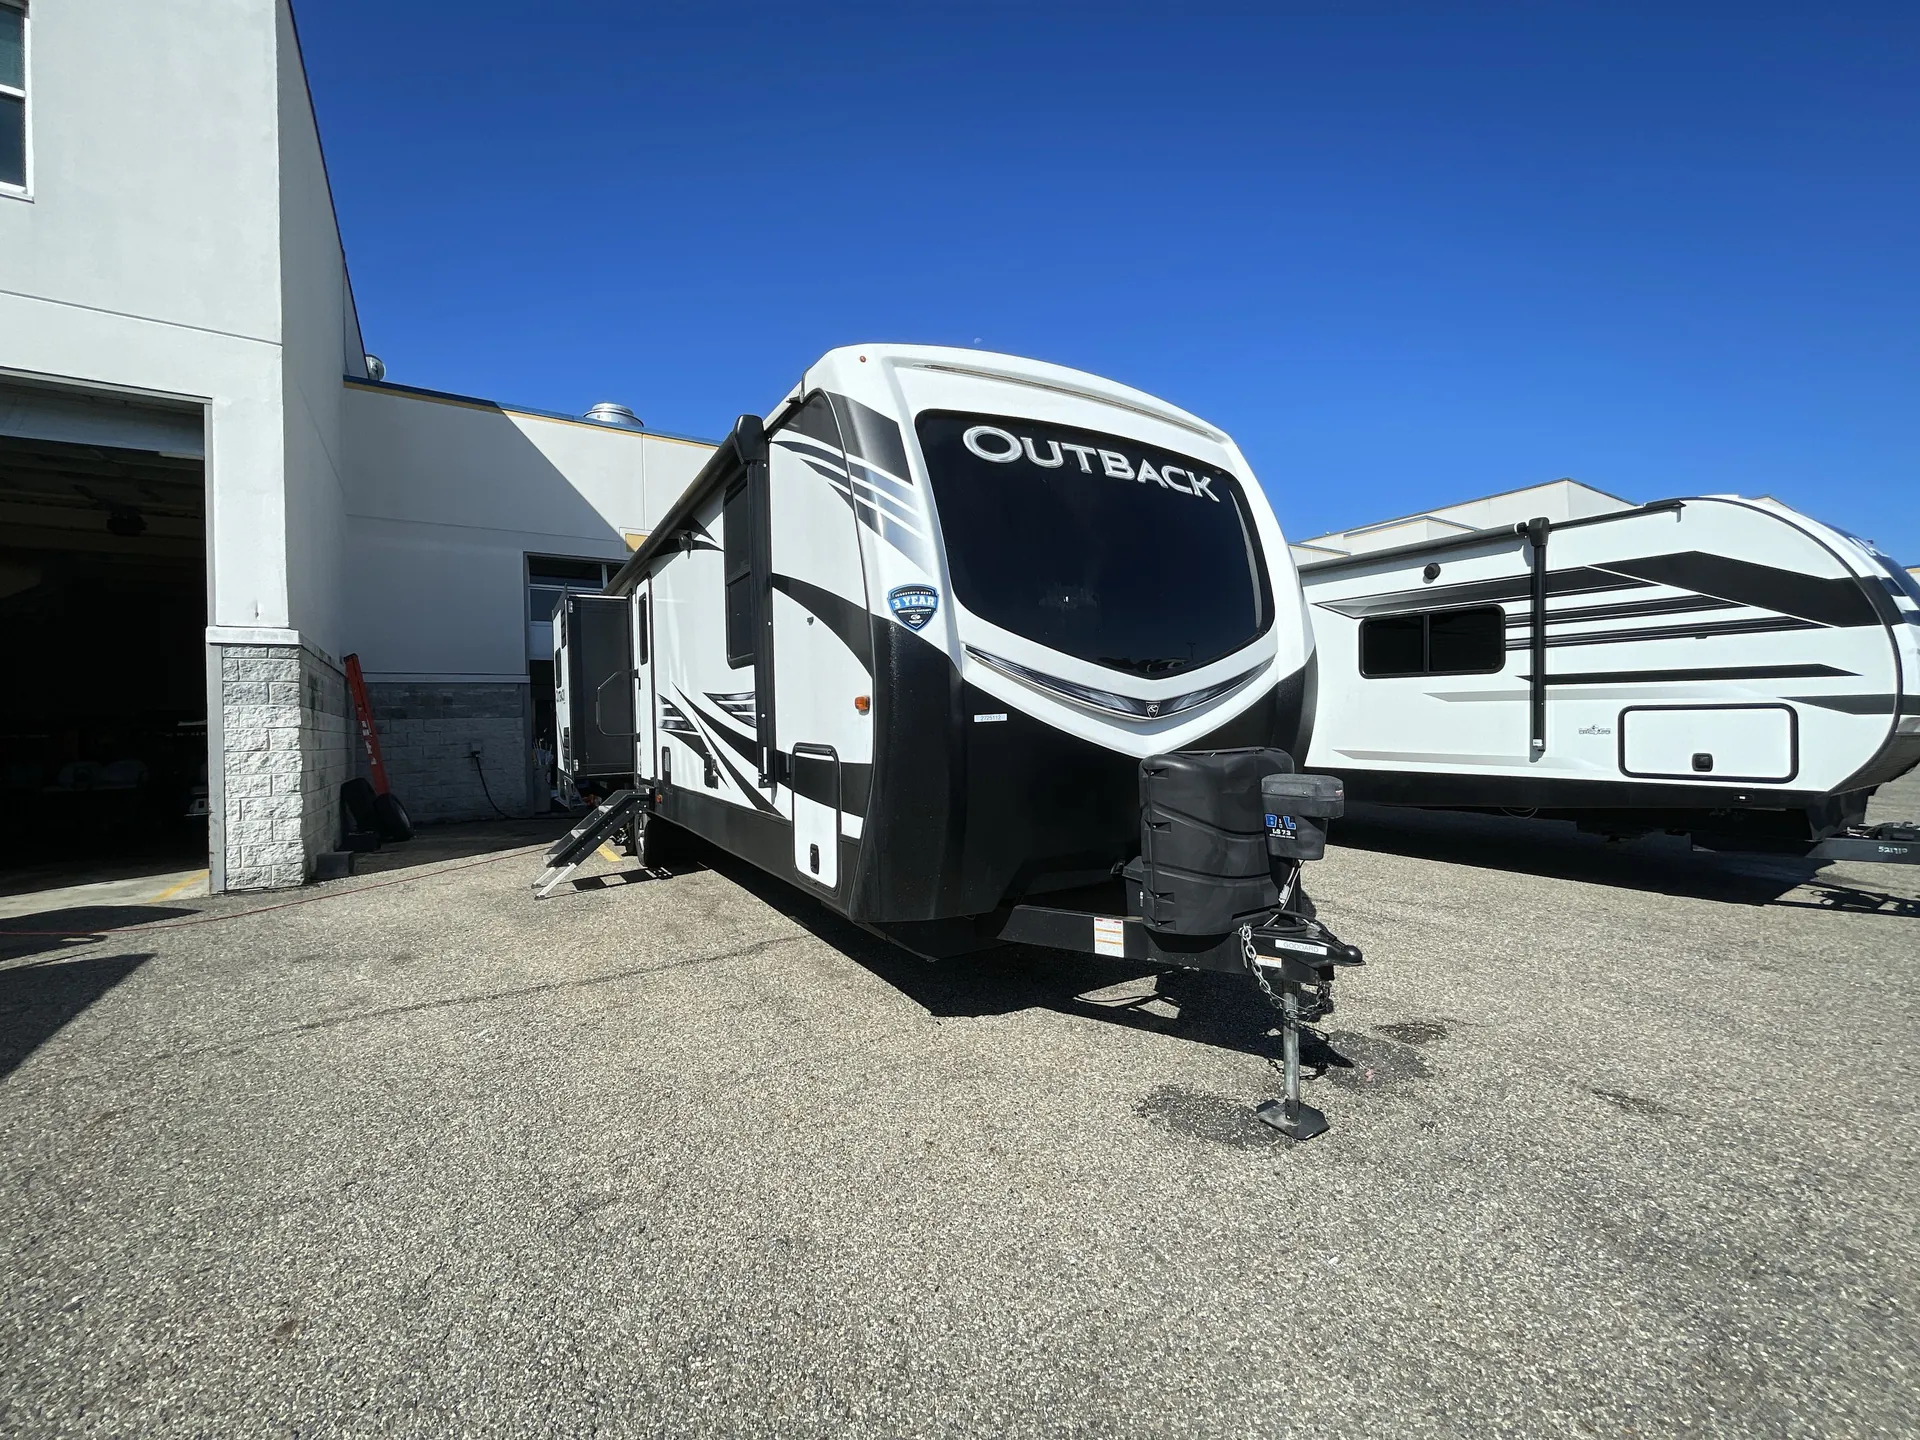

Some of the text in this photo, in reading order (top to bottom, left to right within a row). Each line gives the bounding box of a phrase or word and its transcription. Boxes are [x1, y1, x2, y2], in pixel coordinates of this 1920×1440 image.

[963, 425, 1220, 502] OUTBACK
[893, 595, 935, 609] 3 YEAR
[1283, 941, 1320, 954] GODDARD
